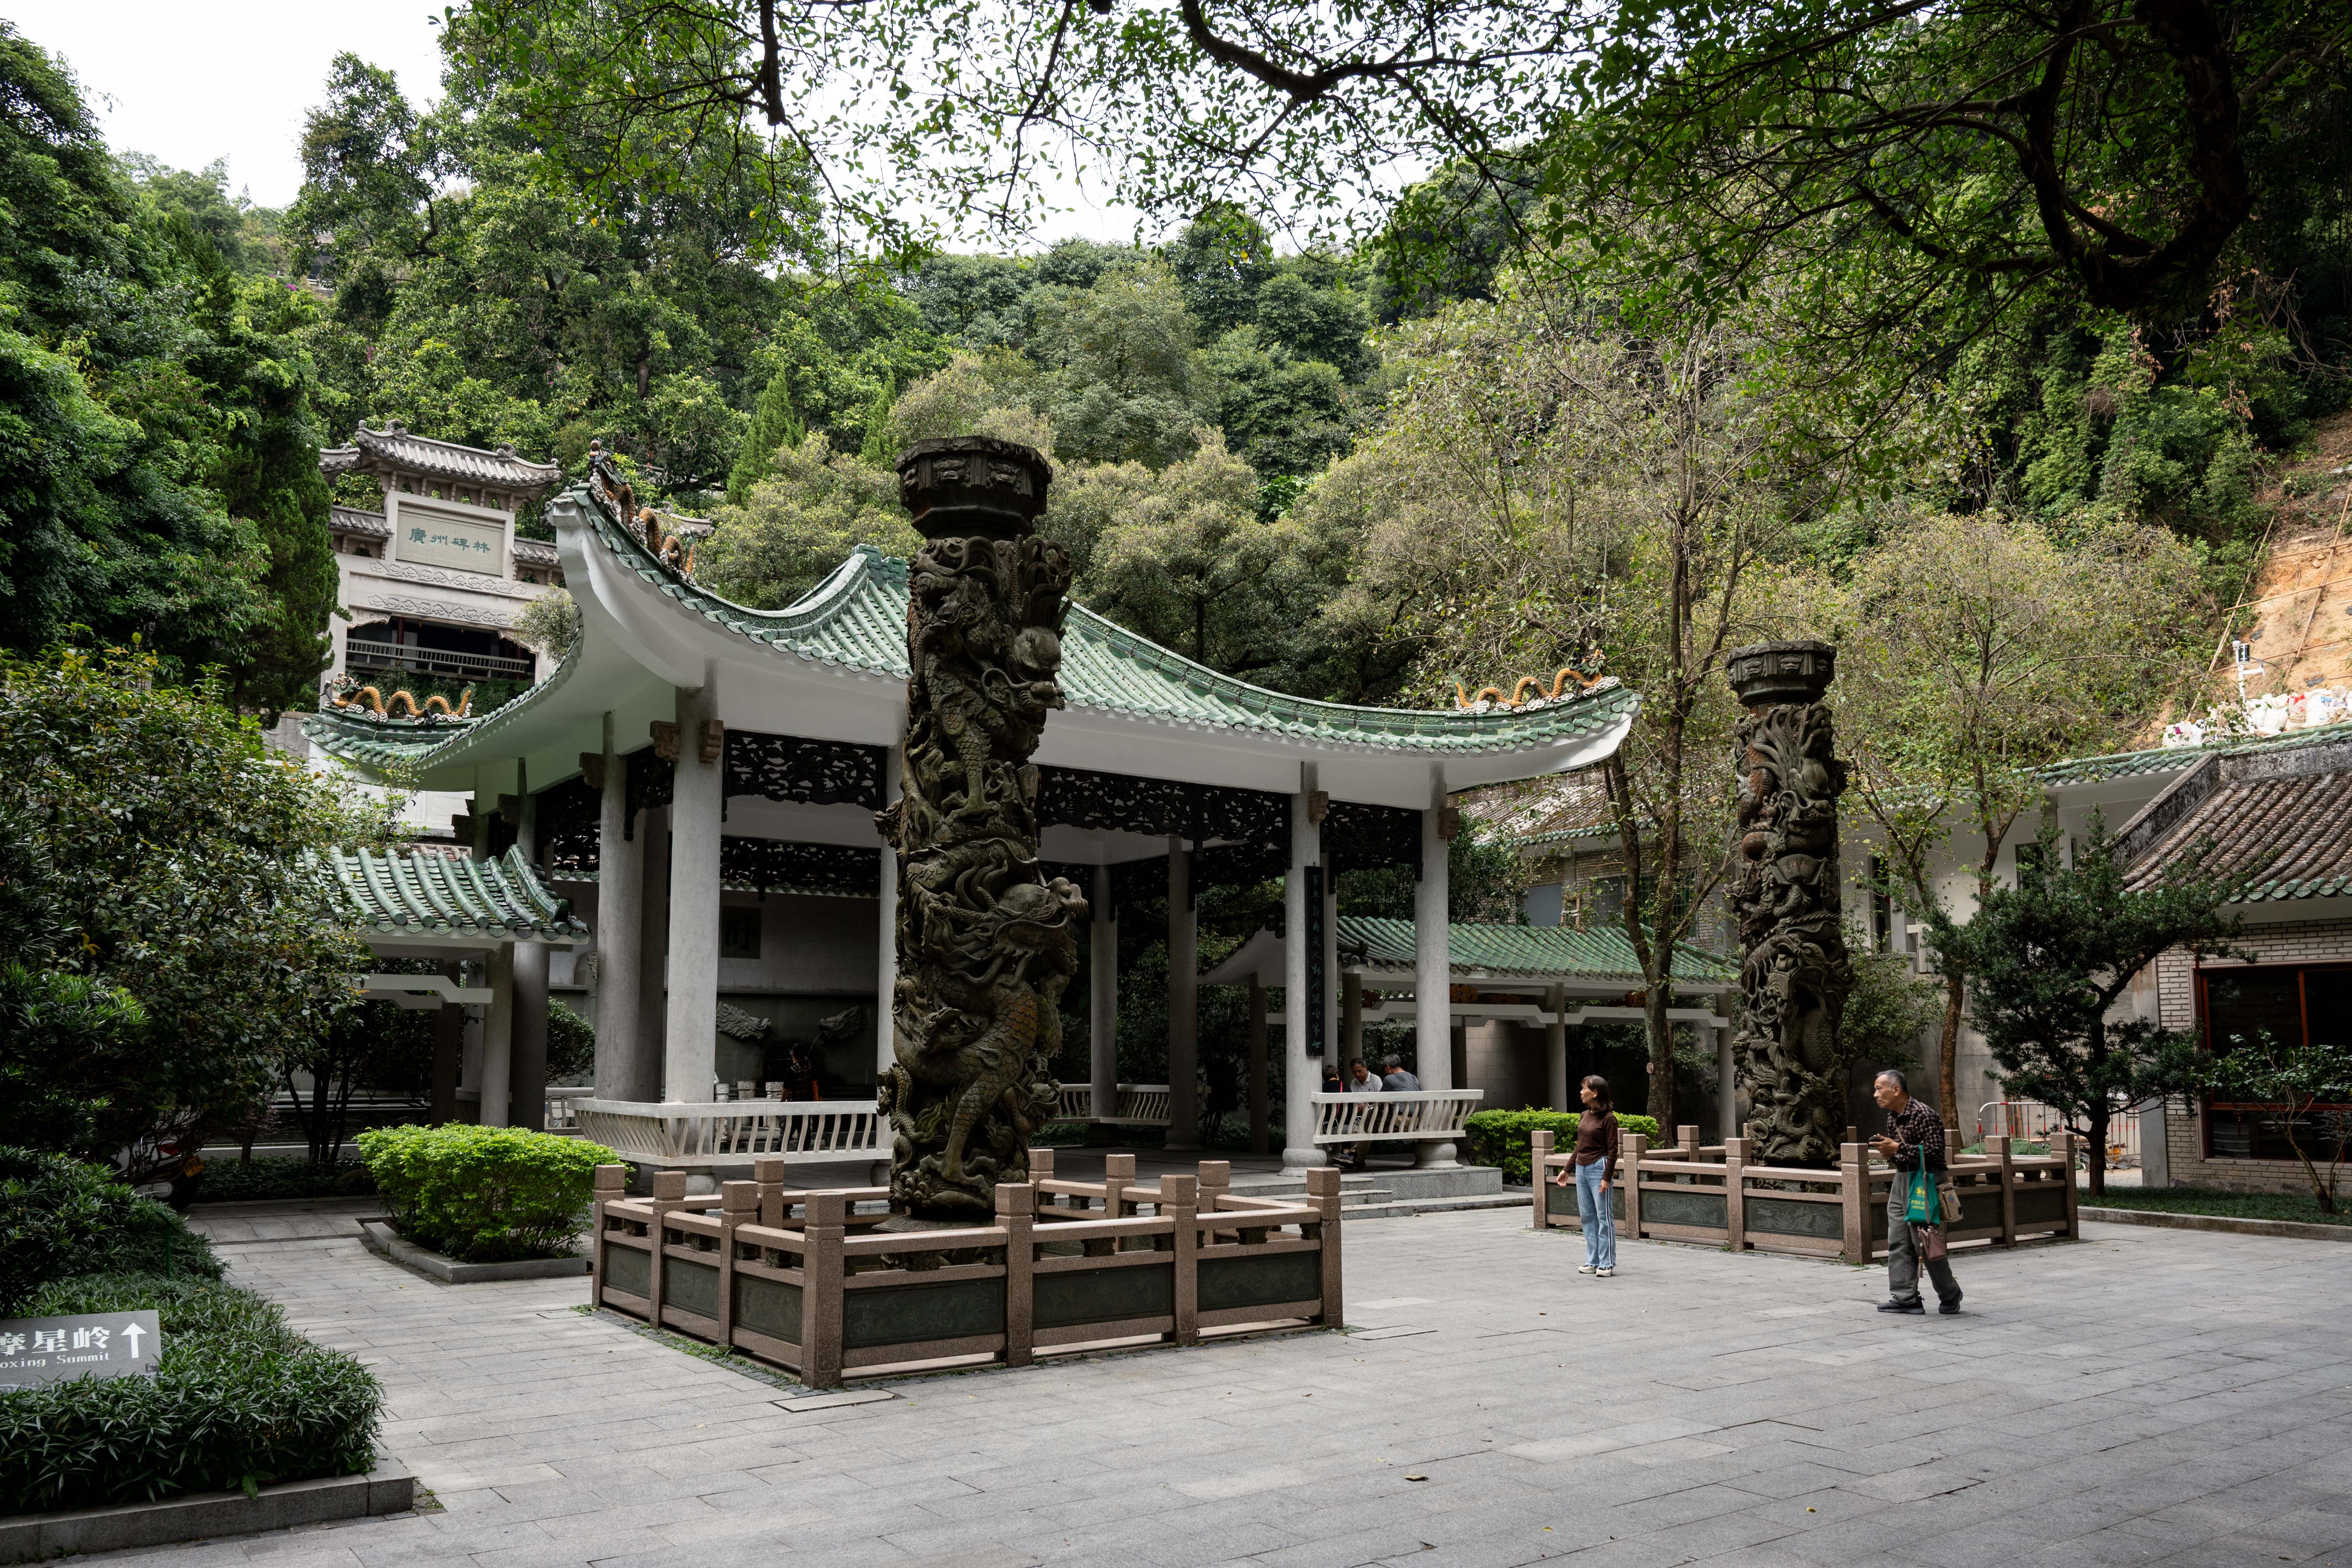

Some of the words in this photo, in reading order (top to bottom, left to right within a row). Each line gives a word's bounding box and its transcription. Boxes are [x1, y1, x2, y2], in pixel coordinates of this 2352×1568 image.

[409, 528, 491, 553] 廣州碑林
[0, 1326, 111, 1356] 摩星岭
[56, 1352, 110, 1364] Summit
